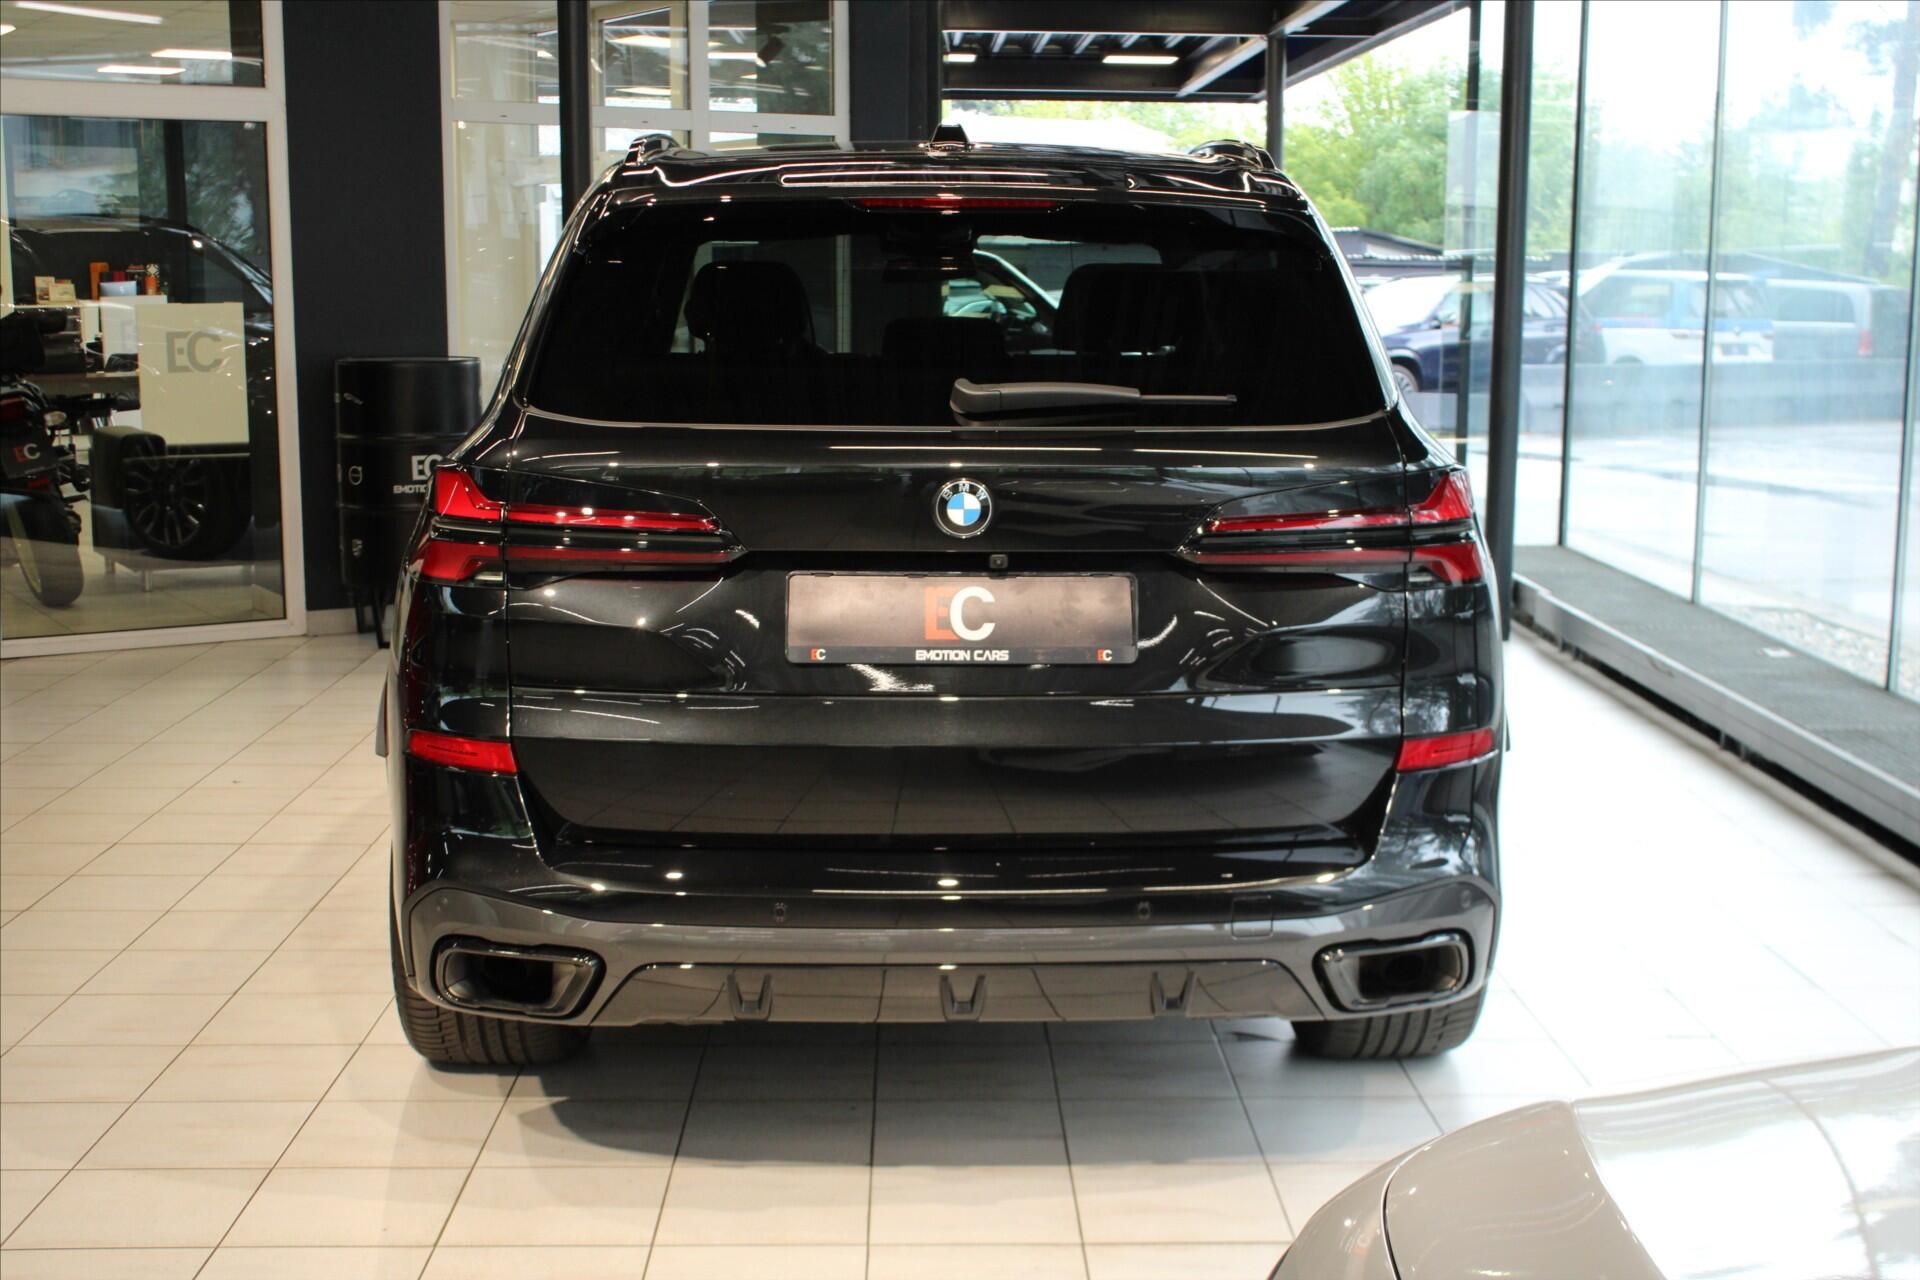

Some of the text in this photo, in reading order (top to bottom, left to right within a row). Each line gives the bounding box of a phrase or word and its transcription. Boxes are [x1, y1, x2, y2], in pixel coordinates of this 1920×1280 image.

[166, 330, 223, 373] EC
[941, 483, 987, 500] BMW
[924, 586, 996, 641] EC
[810, 648, 826, 660] EC
[915, 649, 1009, 661] EMOTION CARS
[1096, 648, 1112, 661] EC
